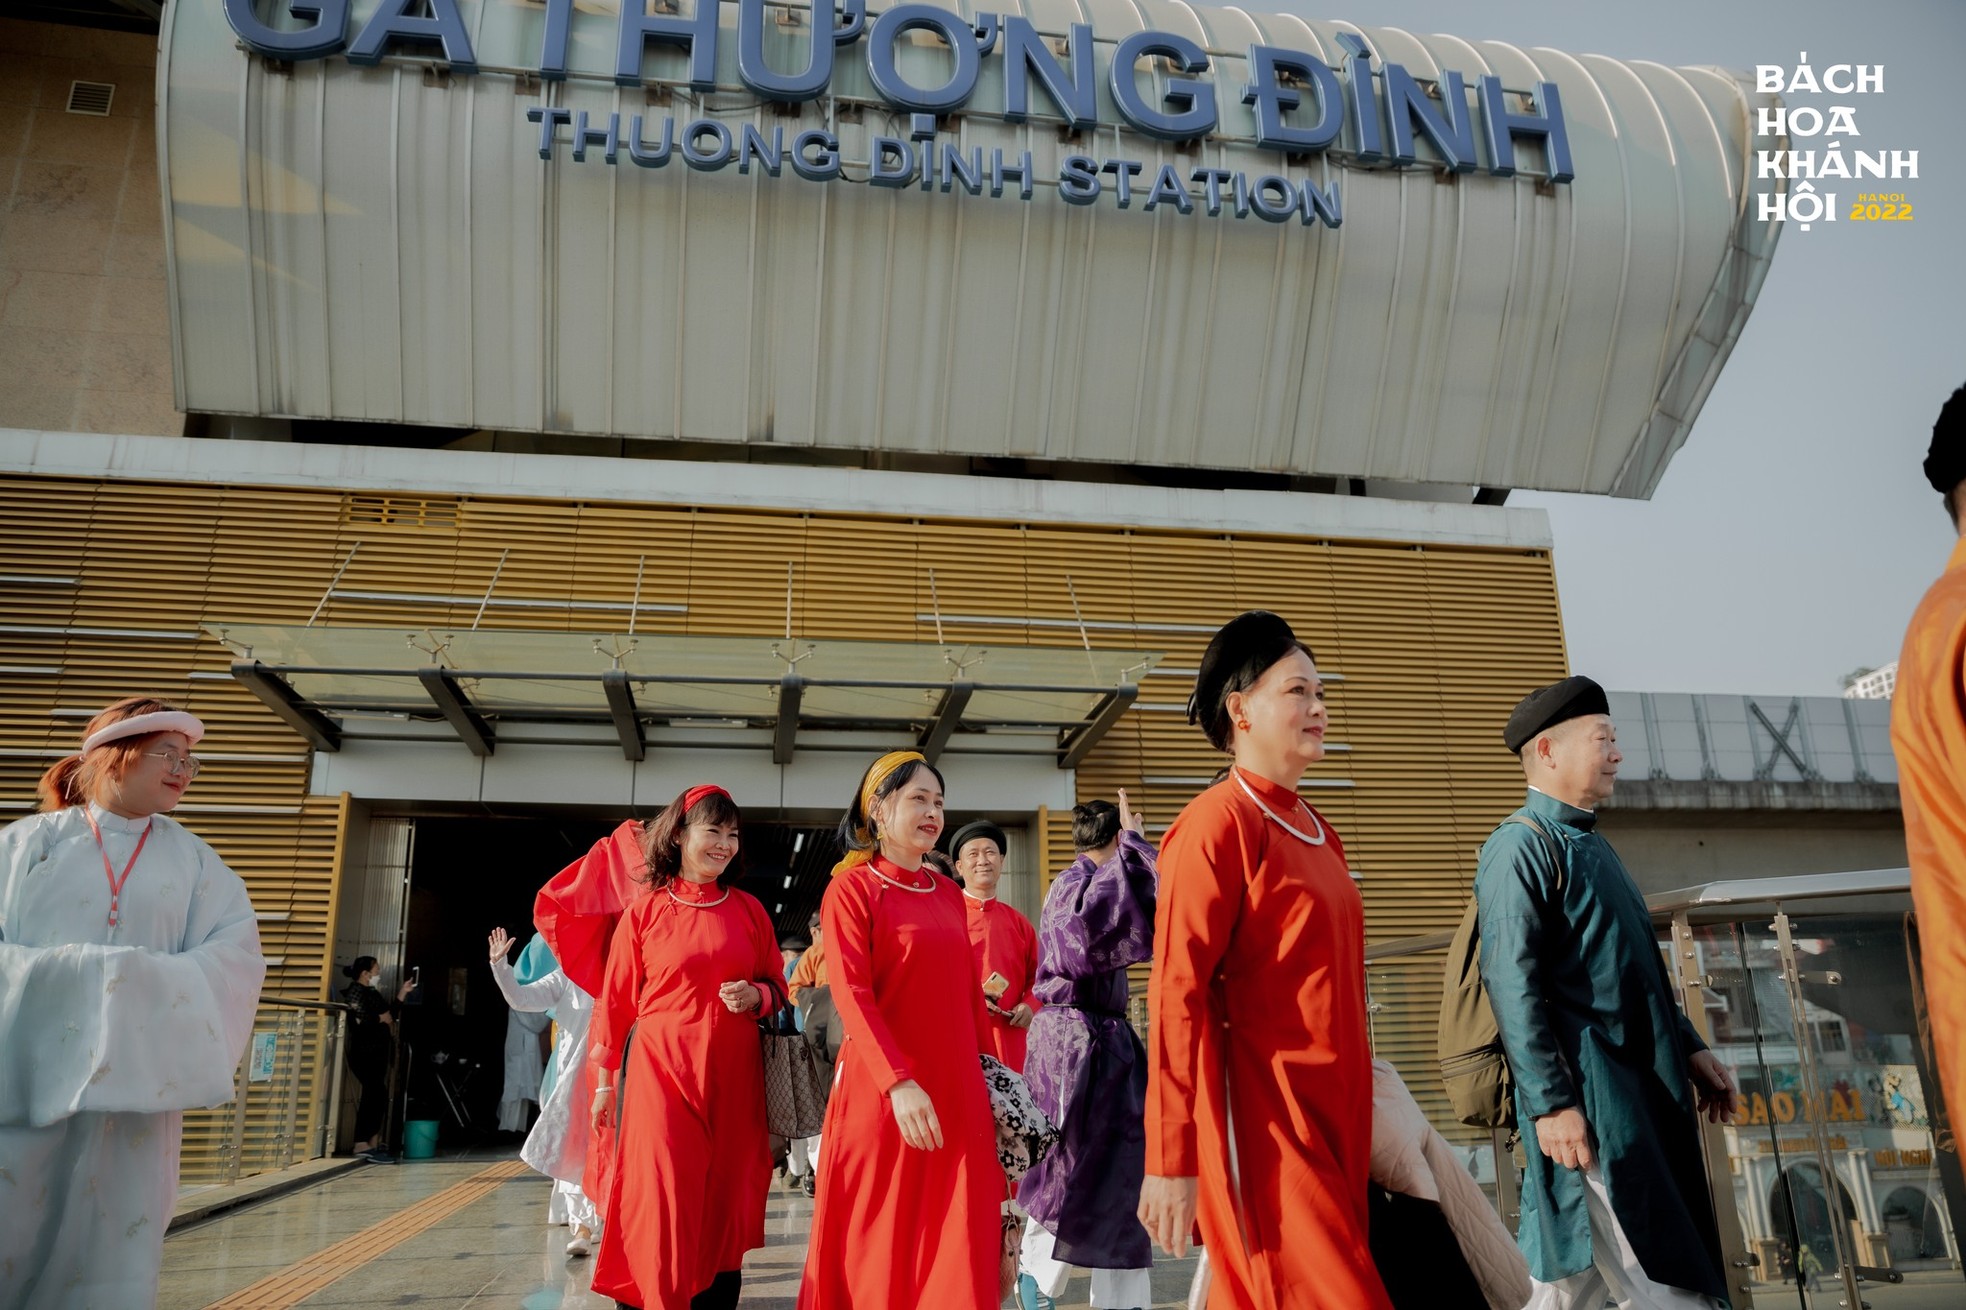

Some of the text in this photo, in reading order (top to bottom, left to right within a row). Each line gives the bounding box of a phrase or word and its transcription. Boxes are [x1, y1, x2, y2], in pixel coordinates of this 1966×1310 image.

[224, 0, 478, 74] GA
[1241, 31, 1575, 184] ĐÌNH
[526, 107, 840, 182] THUONG
[1058, 154, 1342, 229] STATION
